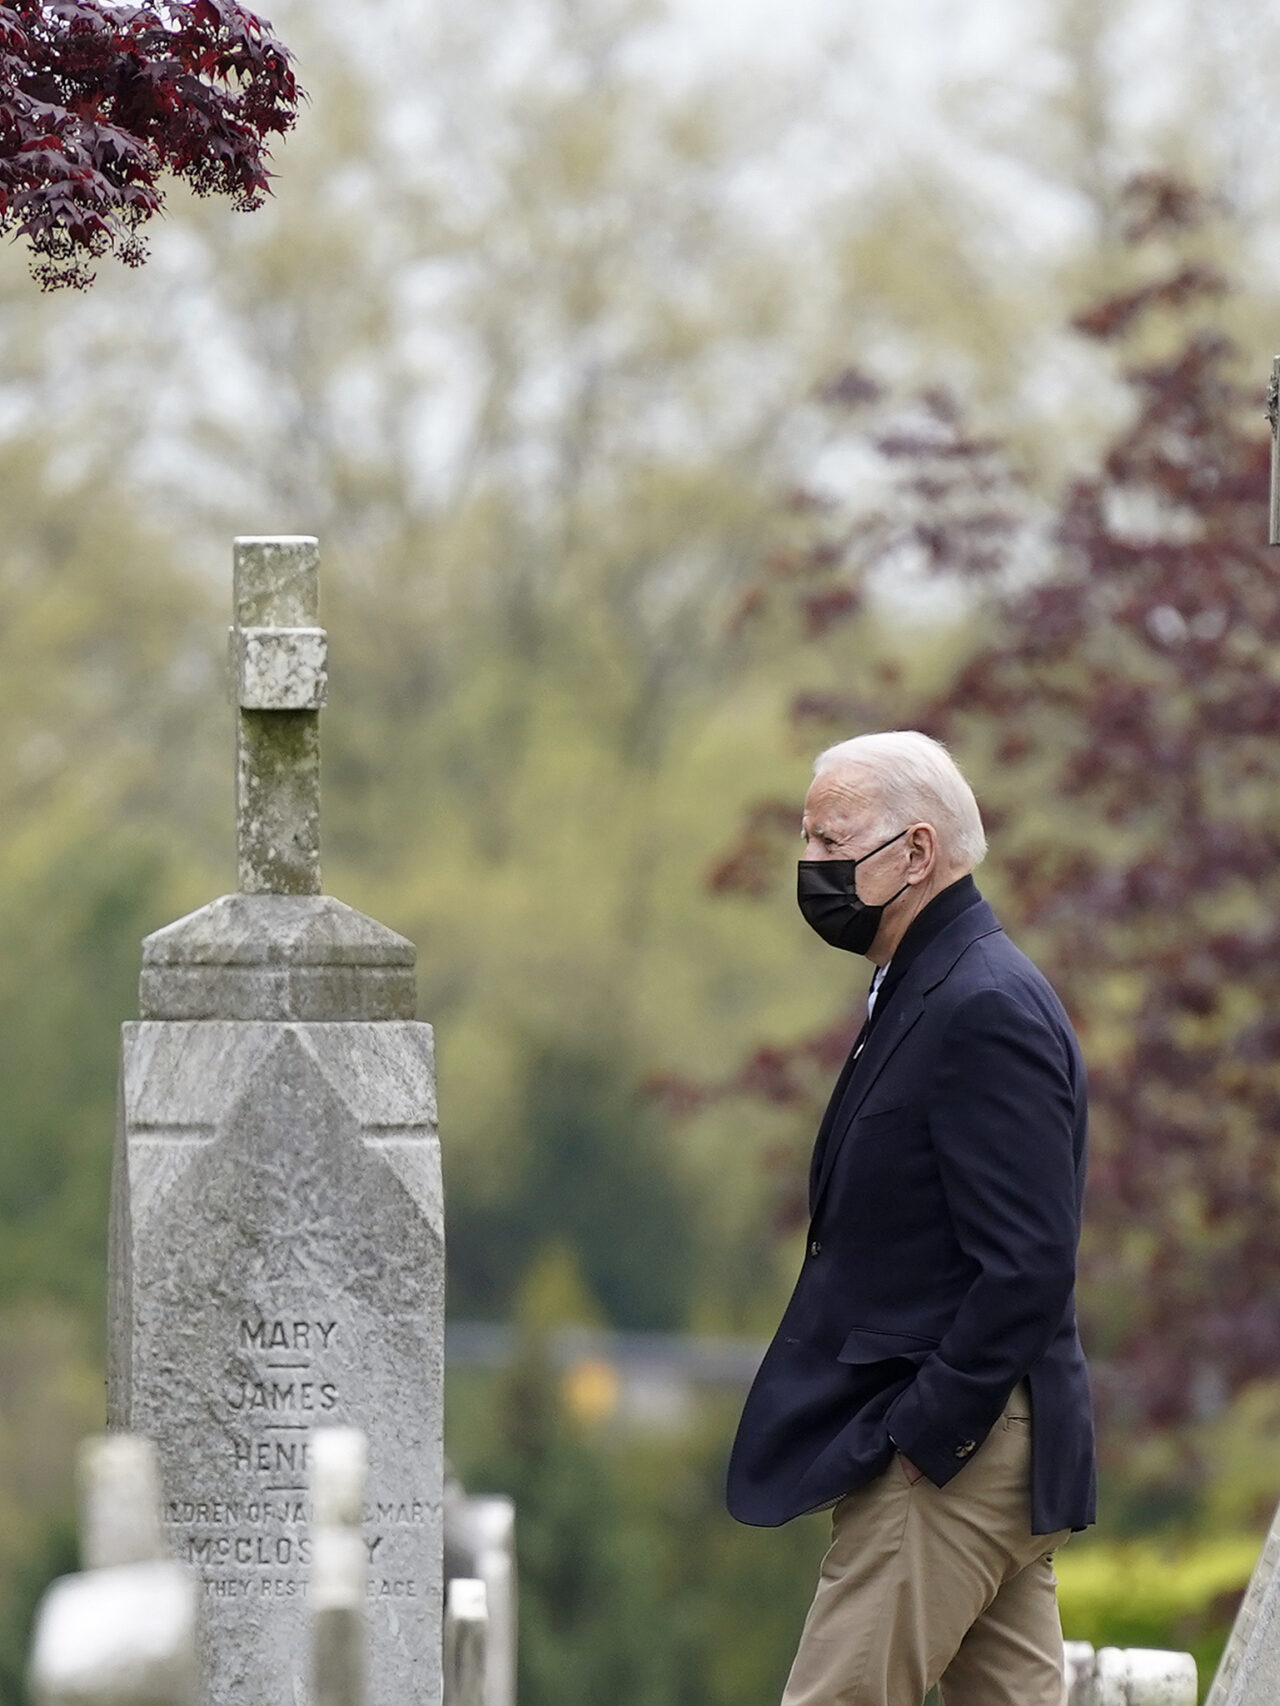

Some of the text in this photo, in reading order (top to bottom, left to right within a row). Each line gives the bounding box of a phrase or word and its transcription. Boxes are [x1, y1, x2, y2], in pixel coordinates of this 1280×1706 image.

[240, 1320, 338, 1350] MARY
[228, 1382, 338, 1412] JAMES
[232, 1442, 310, 1472] HEN
[163, 1501, 240, 1524] ILDREN
[247, 1501, 273, 1523] OF
[376, 1501, 441, 1524] MARY
[187, 1536, 384, 1566] McCLOSY
[203, 1579, 417, 1598] THEY REST EACE
